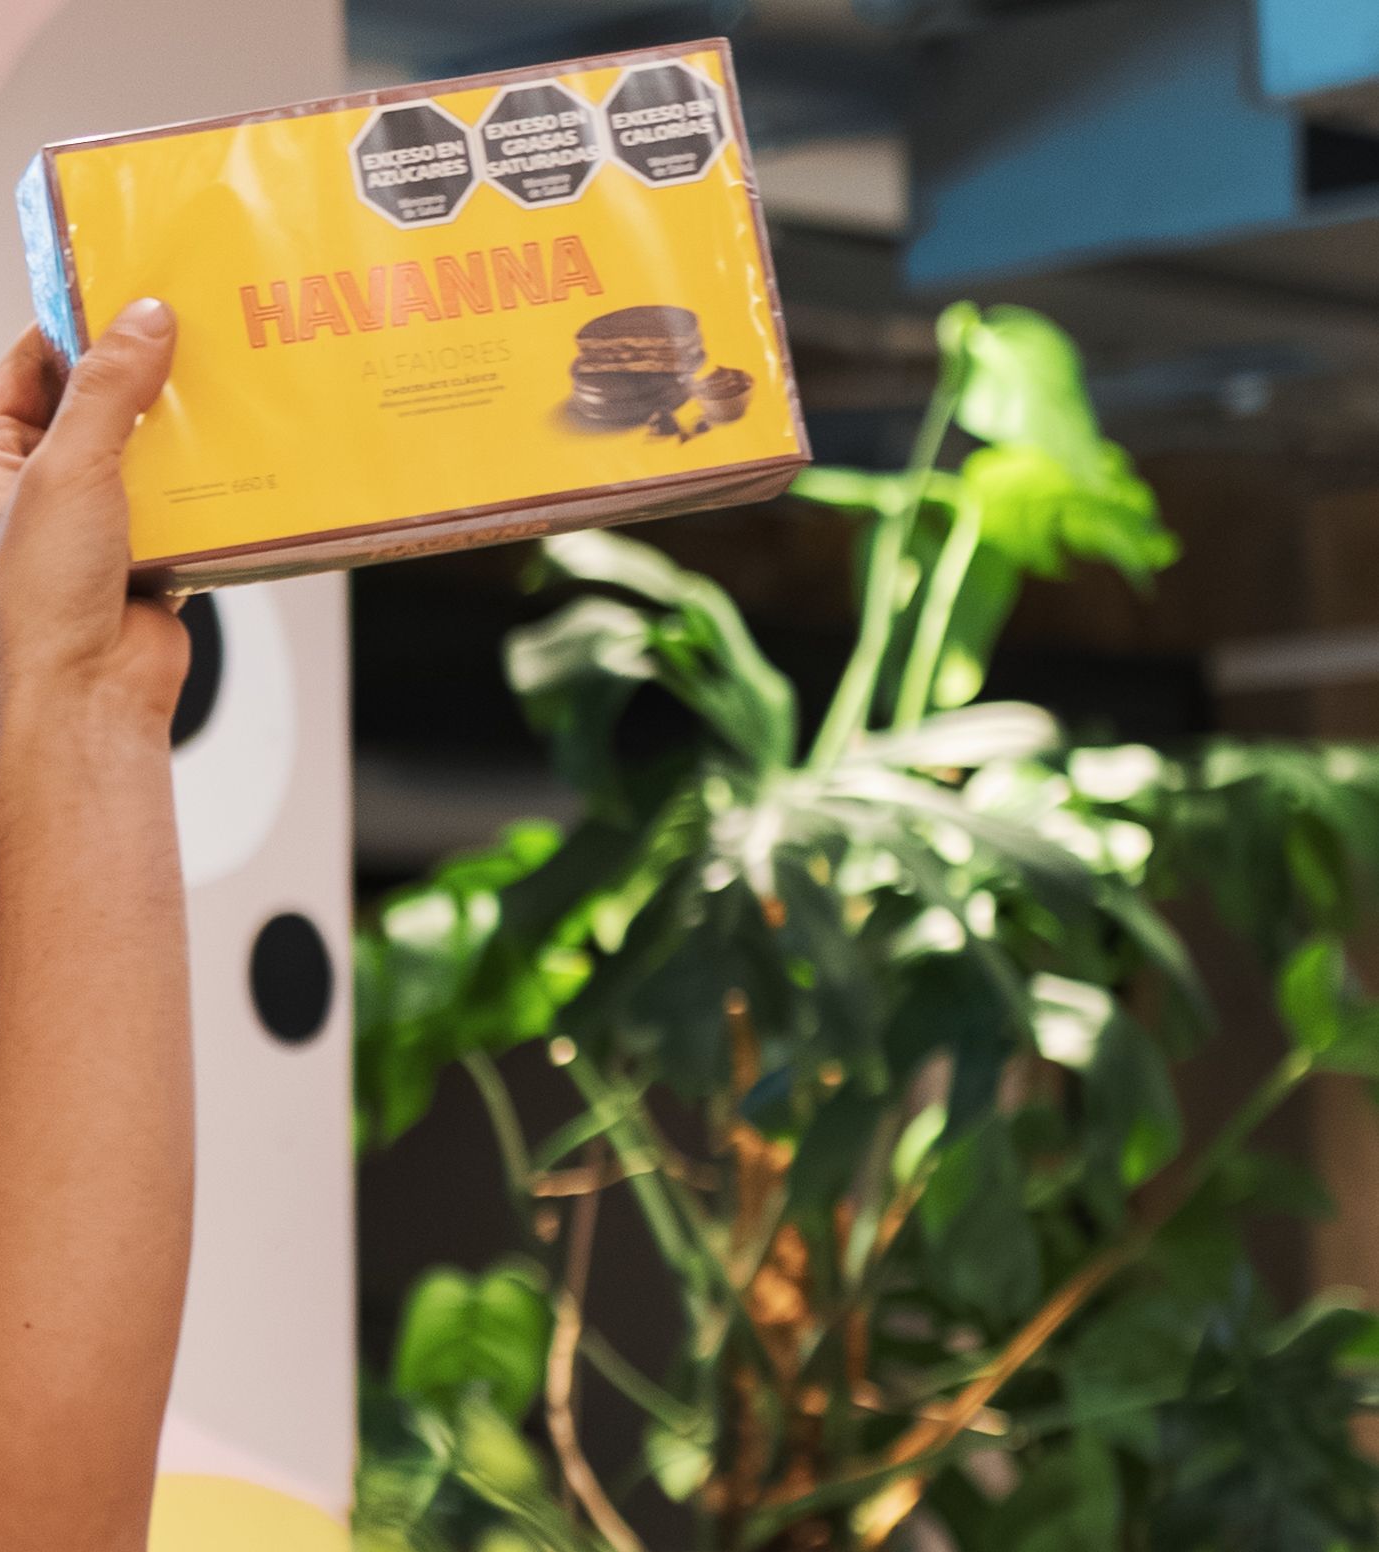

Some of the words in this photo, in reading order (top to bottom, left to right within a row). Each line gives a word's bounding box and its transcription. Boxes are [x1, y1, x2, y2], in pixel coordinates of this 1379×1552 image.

[484, 113, 559, 141] EXCESO
[558, 108, 588, 129] EN
[611, 103, 686, 130] EXCESO
[685, 97, 716, 118] EN
[501, 129, 580, 156] GRASAS
[619, 114, 716, 147] CALORÍAS
[361, 144, 436, 171] EXCESO
[435, 139, 466, 160] EN
[486, 145, 602, 179] SATURADAS
[367, 158, 469, 190] AZÚCARES
[238, 234, 605, 349] HAVANNA
[360, 338, 514, 383] ALFAJORES
